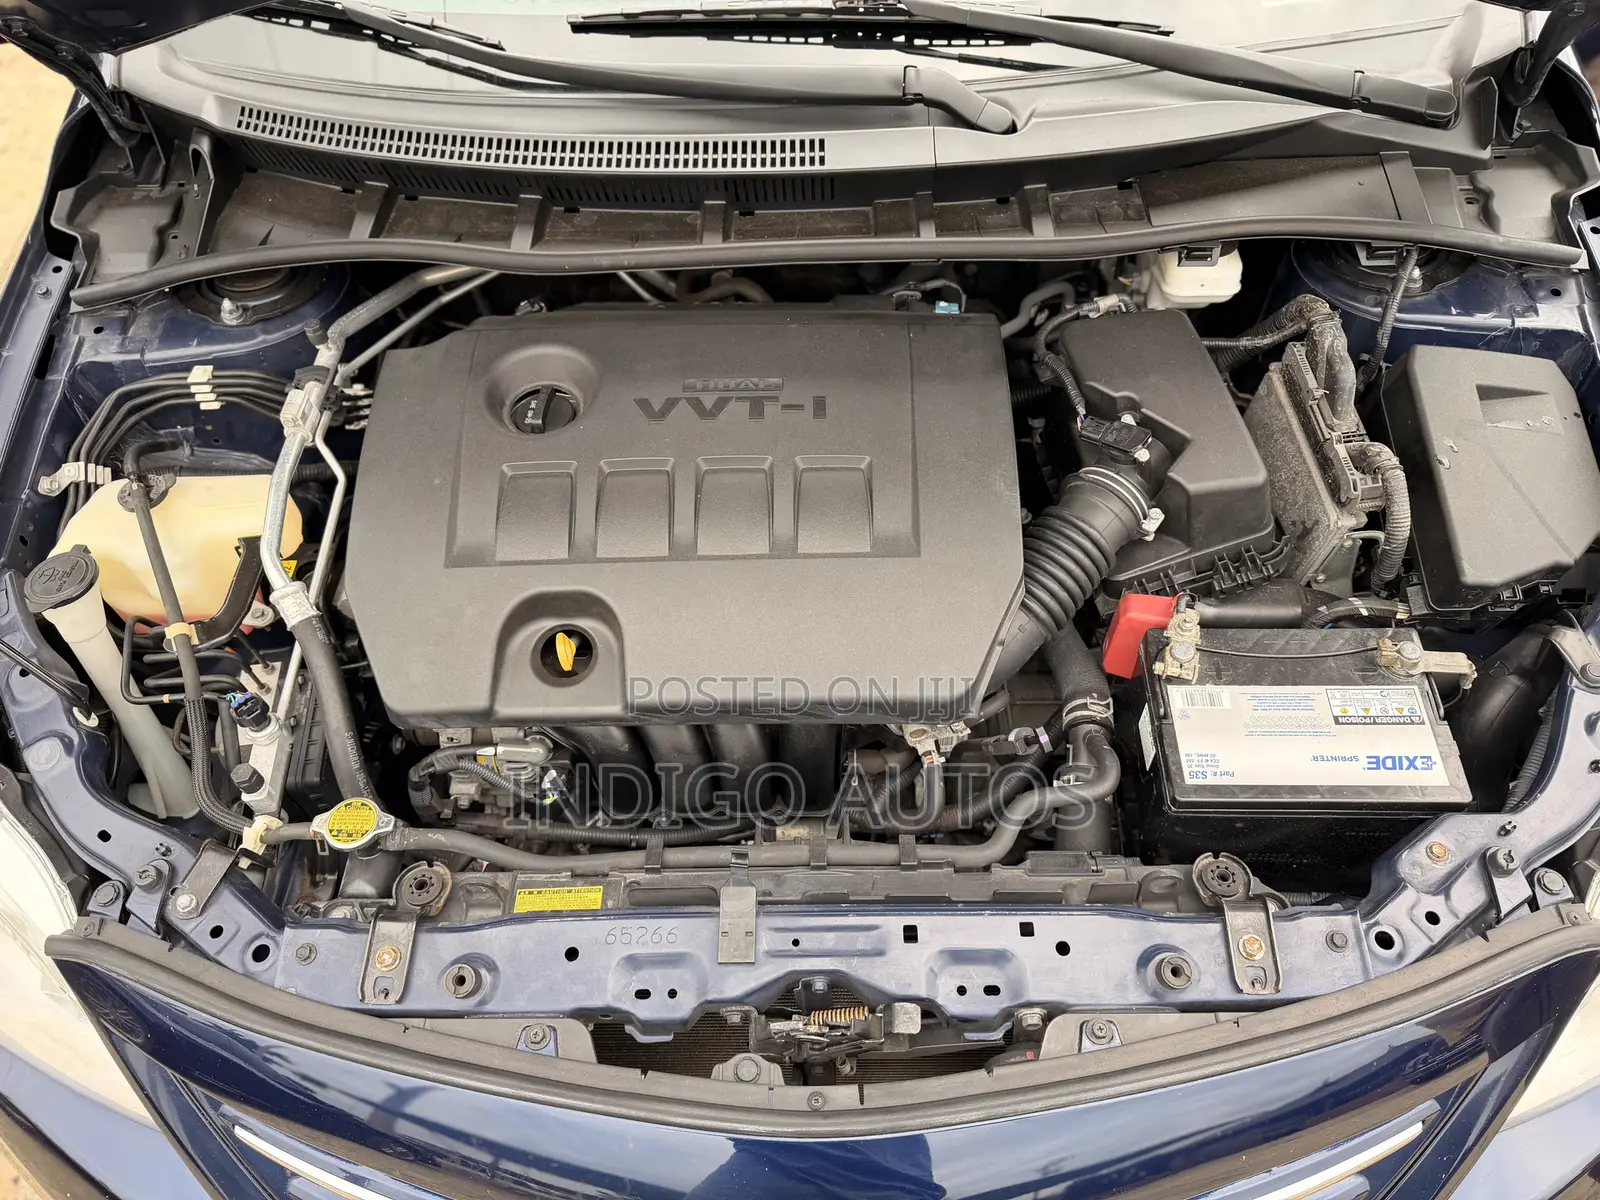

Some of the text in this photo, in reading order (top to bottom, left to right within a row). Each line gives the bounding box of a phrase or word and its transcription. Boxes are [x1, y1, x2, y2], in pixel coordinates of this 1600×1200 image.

[1366, 755, 1437, 771] EXIDE
[1188, 770, 1208, 780] S35
[604, 925, 678, 945] 65266
